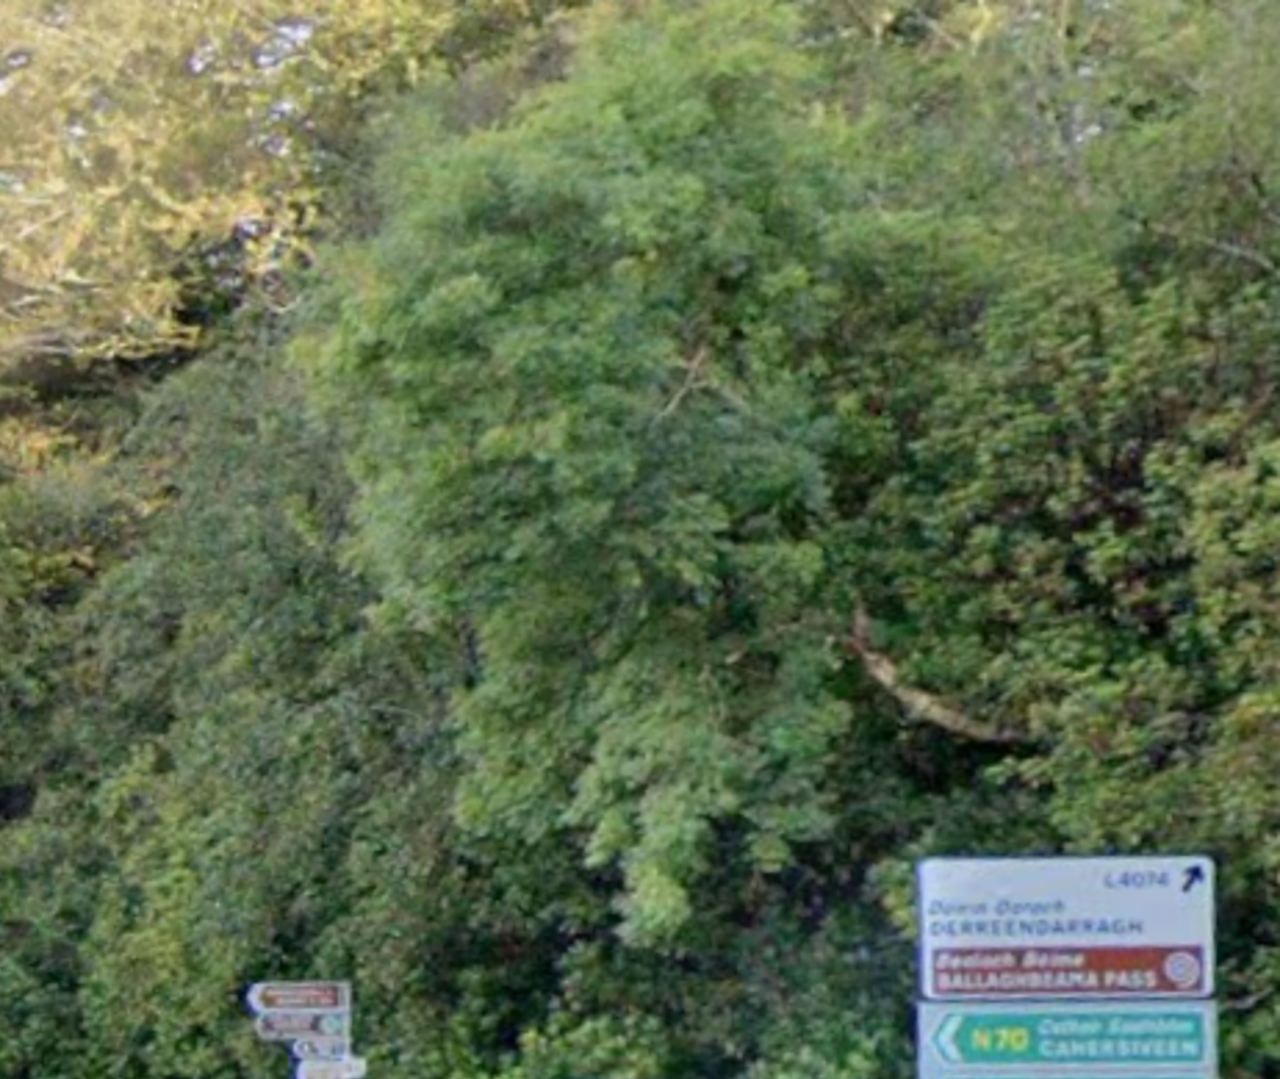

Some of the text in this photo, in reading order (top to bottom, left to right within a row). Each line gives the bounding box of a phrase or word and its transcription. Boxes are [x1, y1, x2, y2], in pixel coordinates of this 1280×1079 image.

[1104, 969, 1158, 988] PASS
[970, 1028, 1031, 1051] N70
[1037, 1039, 1199, 1058] CAHERSIVEEN
